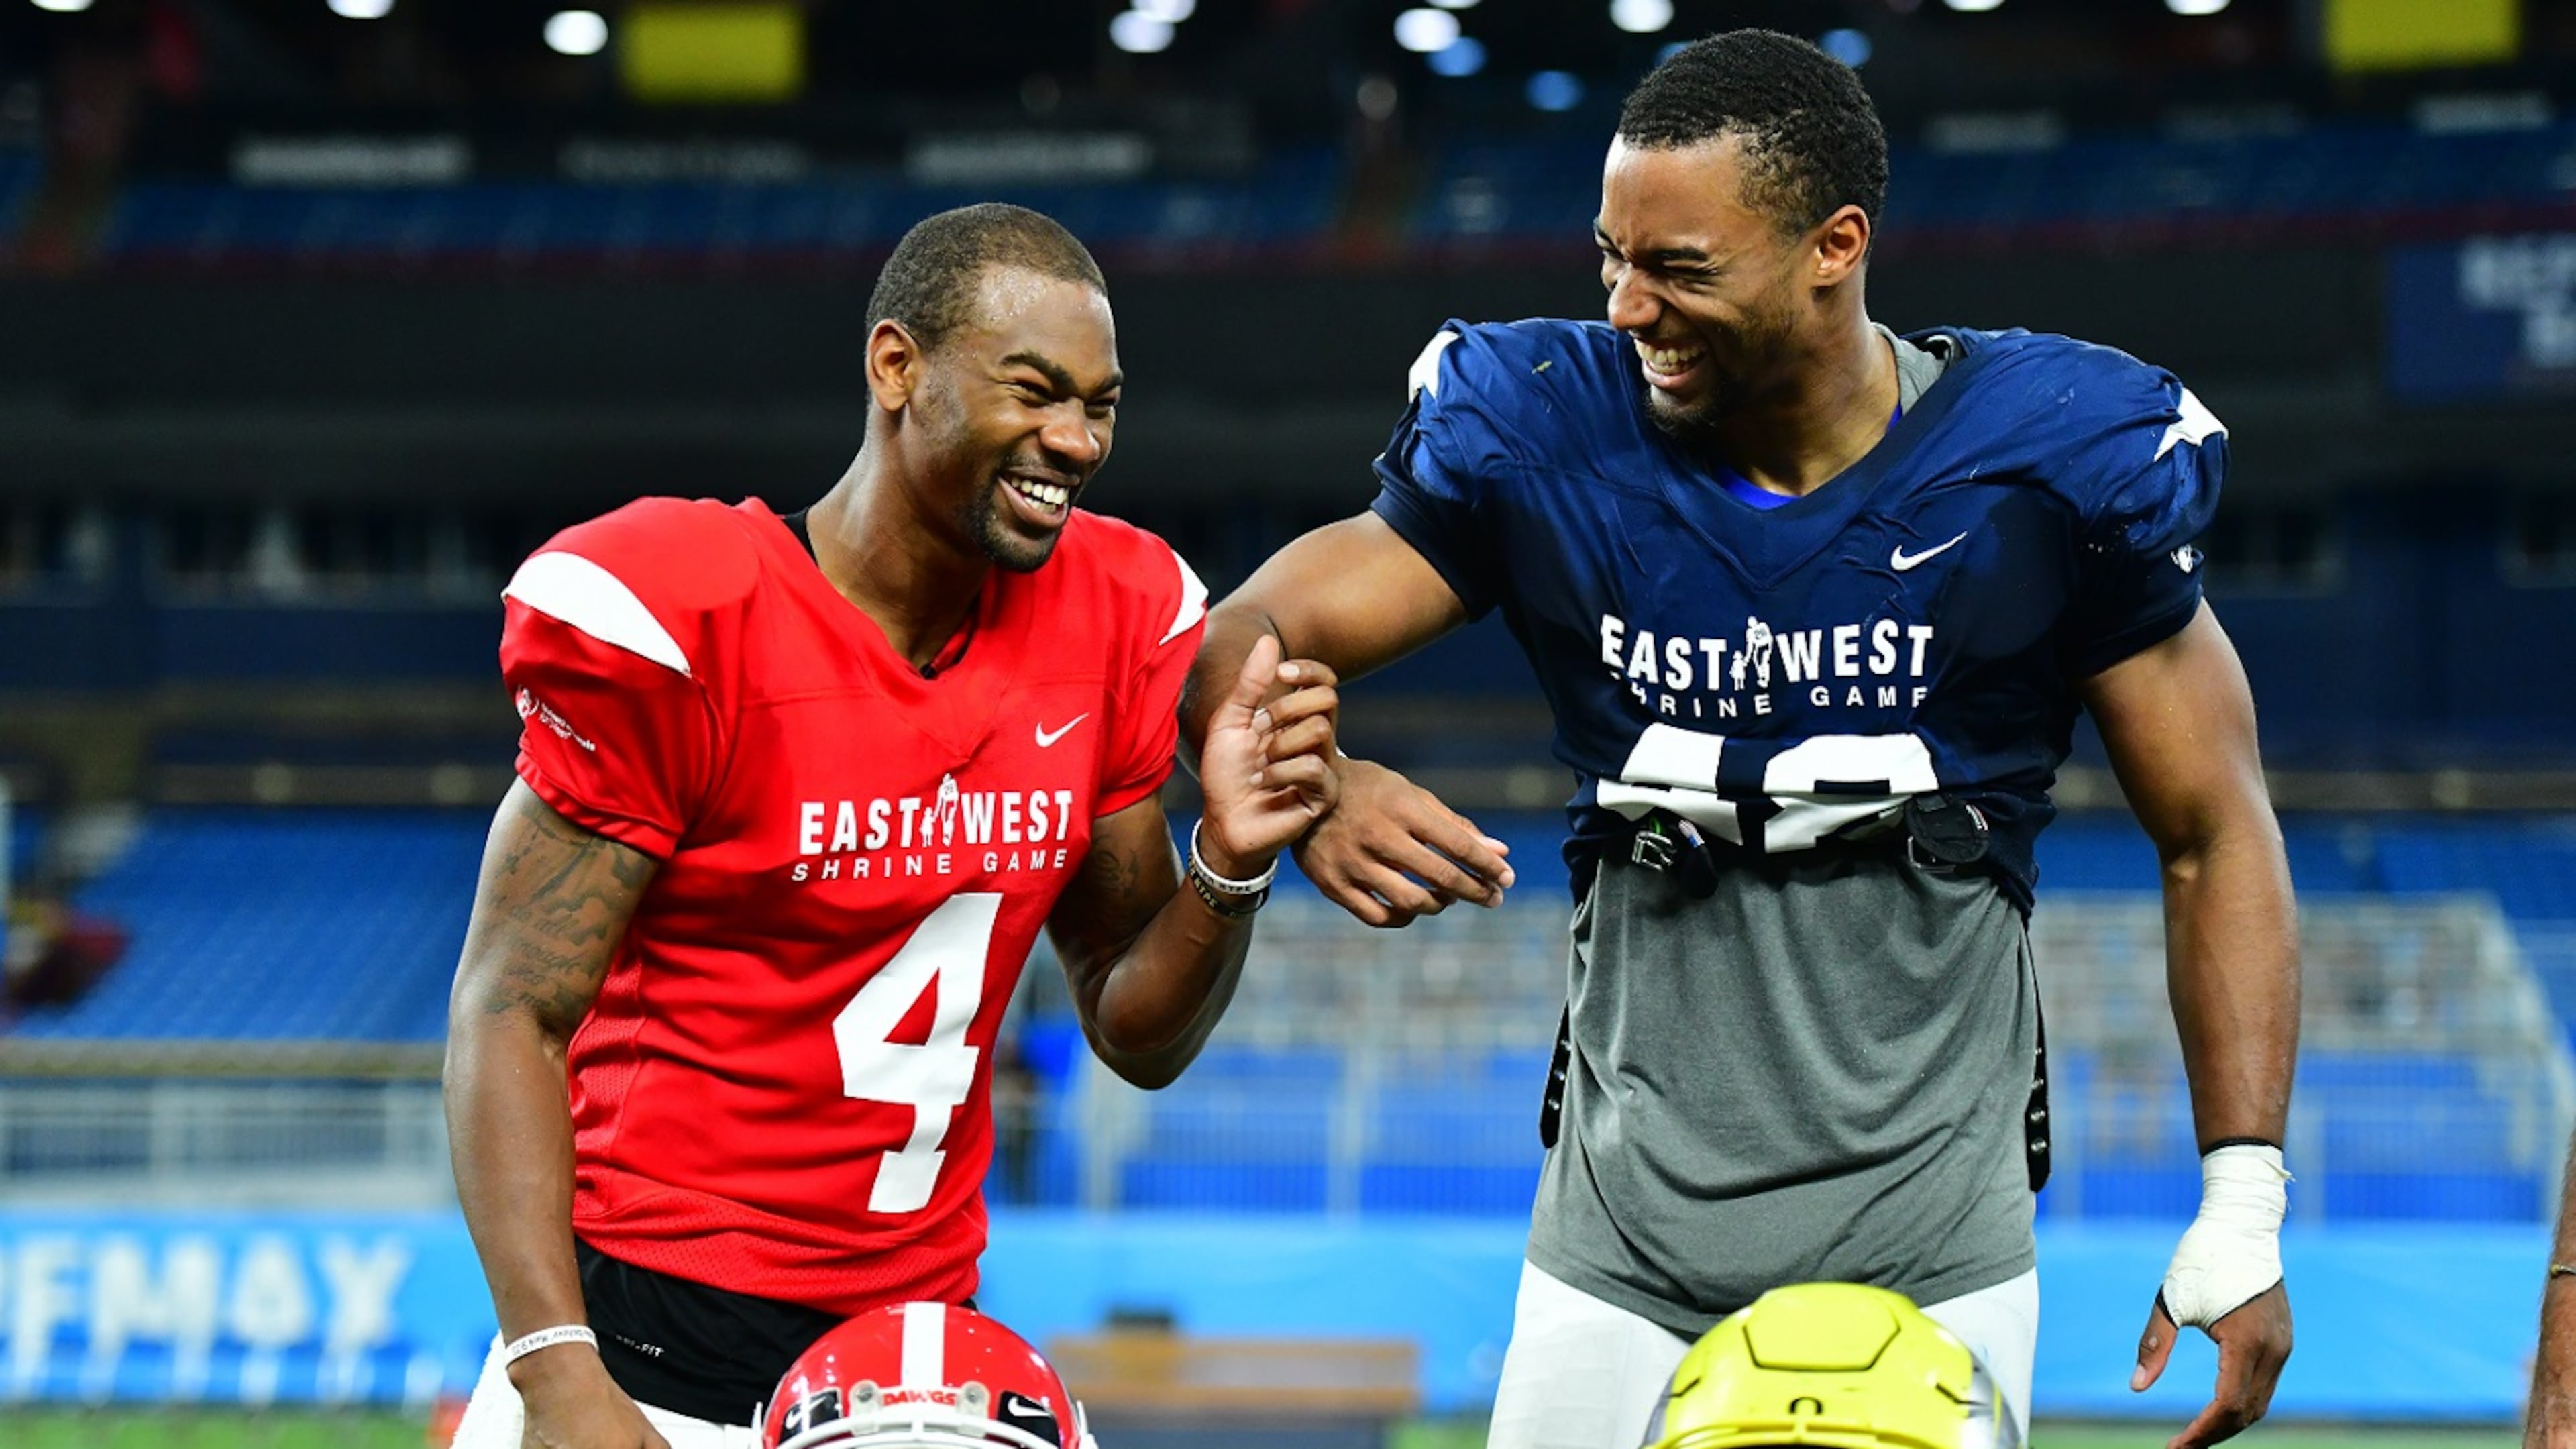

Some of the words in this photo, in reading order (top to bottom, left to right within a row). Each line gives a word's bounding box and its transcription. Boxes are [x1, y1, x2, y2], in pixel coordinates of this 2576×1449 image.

[1601, 614, 1727, 691] EAST
[1776, 619, 1933, 682] WEST
[1611, 671, 1772, 717] RINE
[800, 797, 922, 855] EAST
[961, 790, 1073, 845] WEST
[792, 853, 951, 881] SHRINE
[983, 848, 1067, 872] GAME
[832, 892, 1003, 1213] 4
